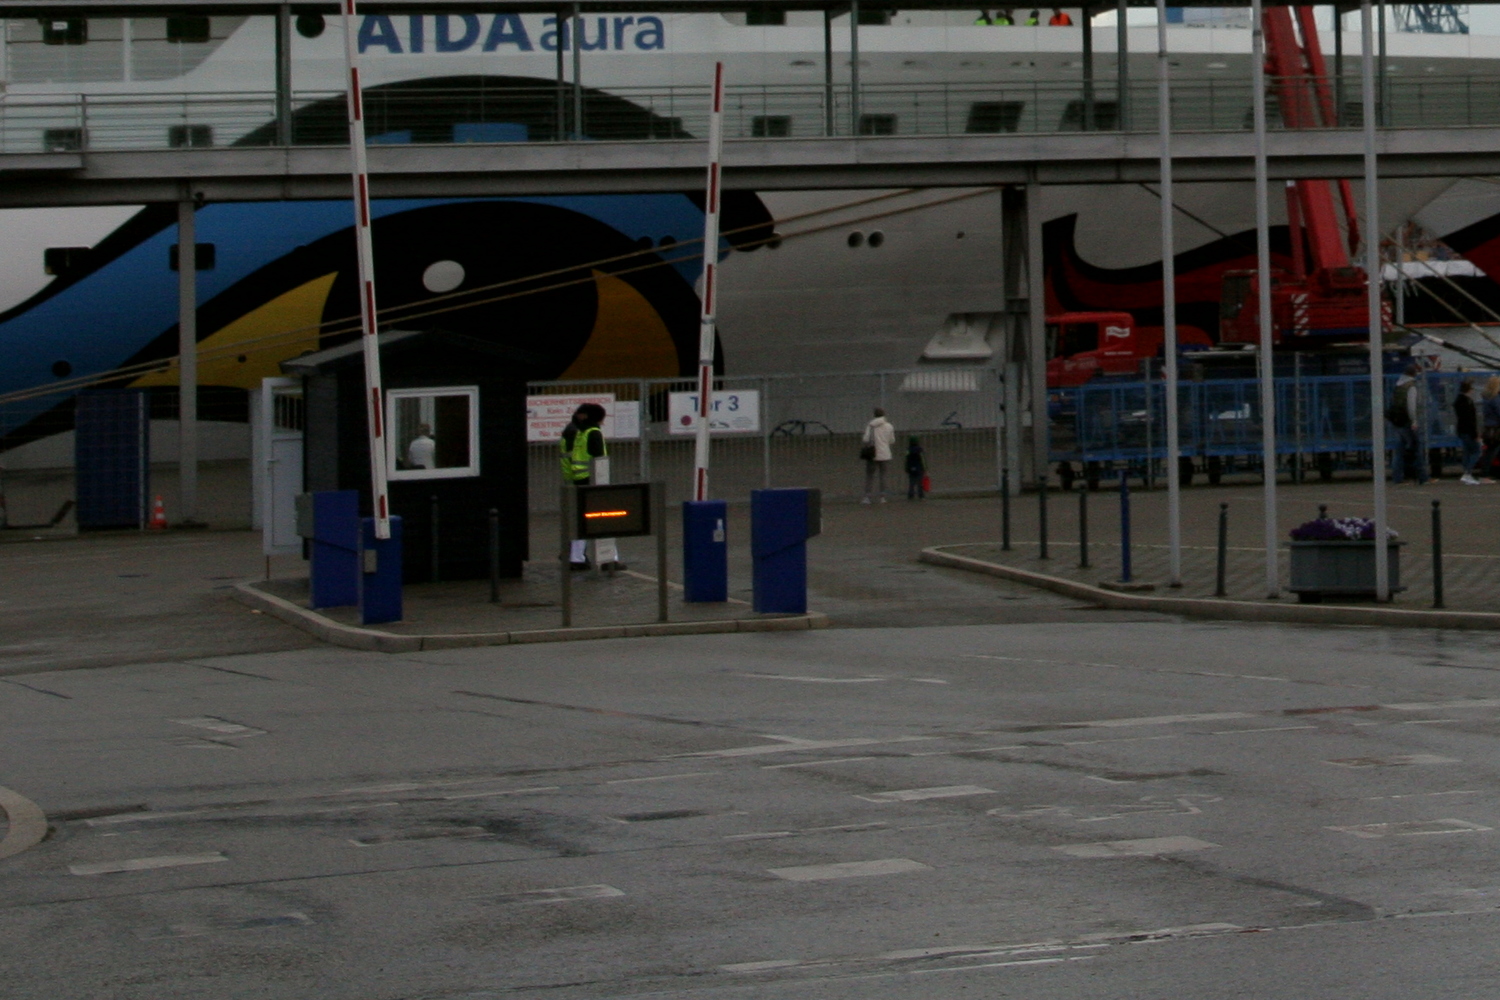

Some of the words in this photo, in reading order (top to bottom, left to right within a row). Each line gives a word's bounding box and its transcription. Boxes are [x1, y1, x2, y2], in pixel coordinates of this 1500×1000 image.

[357, 13, 666, 55] AIDAaura
[689, 397, 721, 411] Tr
[728, 395, 739, 412] 3
